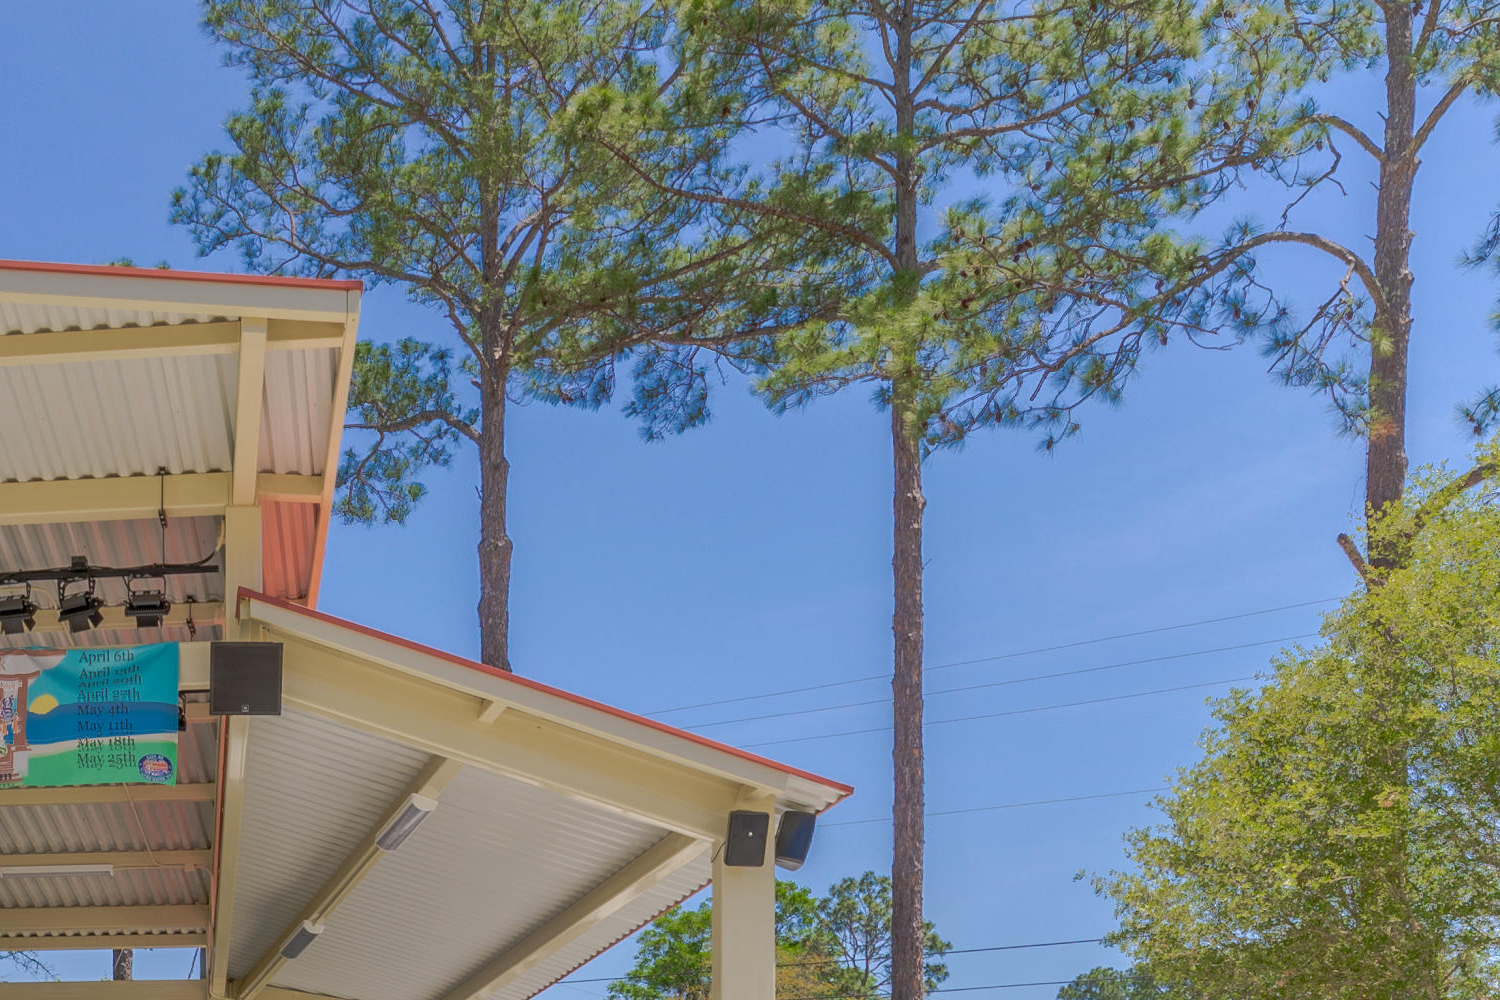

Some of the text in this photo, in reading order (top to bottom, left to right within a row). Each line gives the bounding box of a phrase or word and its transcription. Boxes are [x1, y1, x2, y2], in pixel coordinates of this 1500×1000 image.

[79, 649, 134, 665] April 6th
[79, 667, 110, 680] April
[77, 688, 108, 704] April
[77, 703, 129, 717] May 4th
[77, 718, 133, 732] May 11th
[77, 736, 135, 751] May 18th
[77, 751, 136, 769] May 25th
